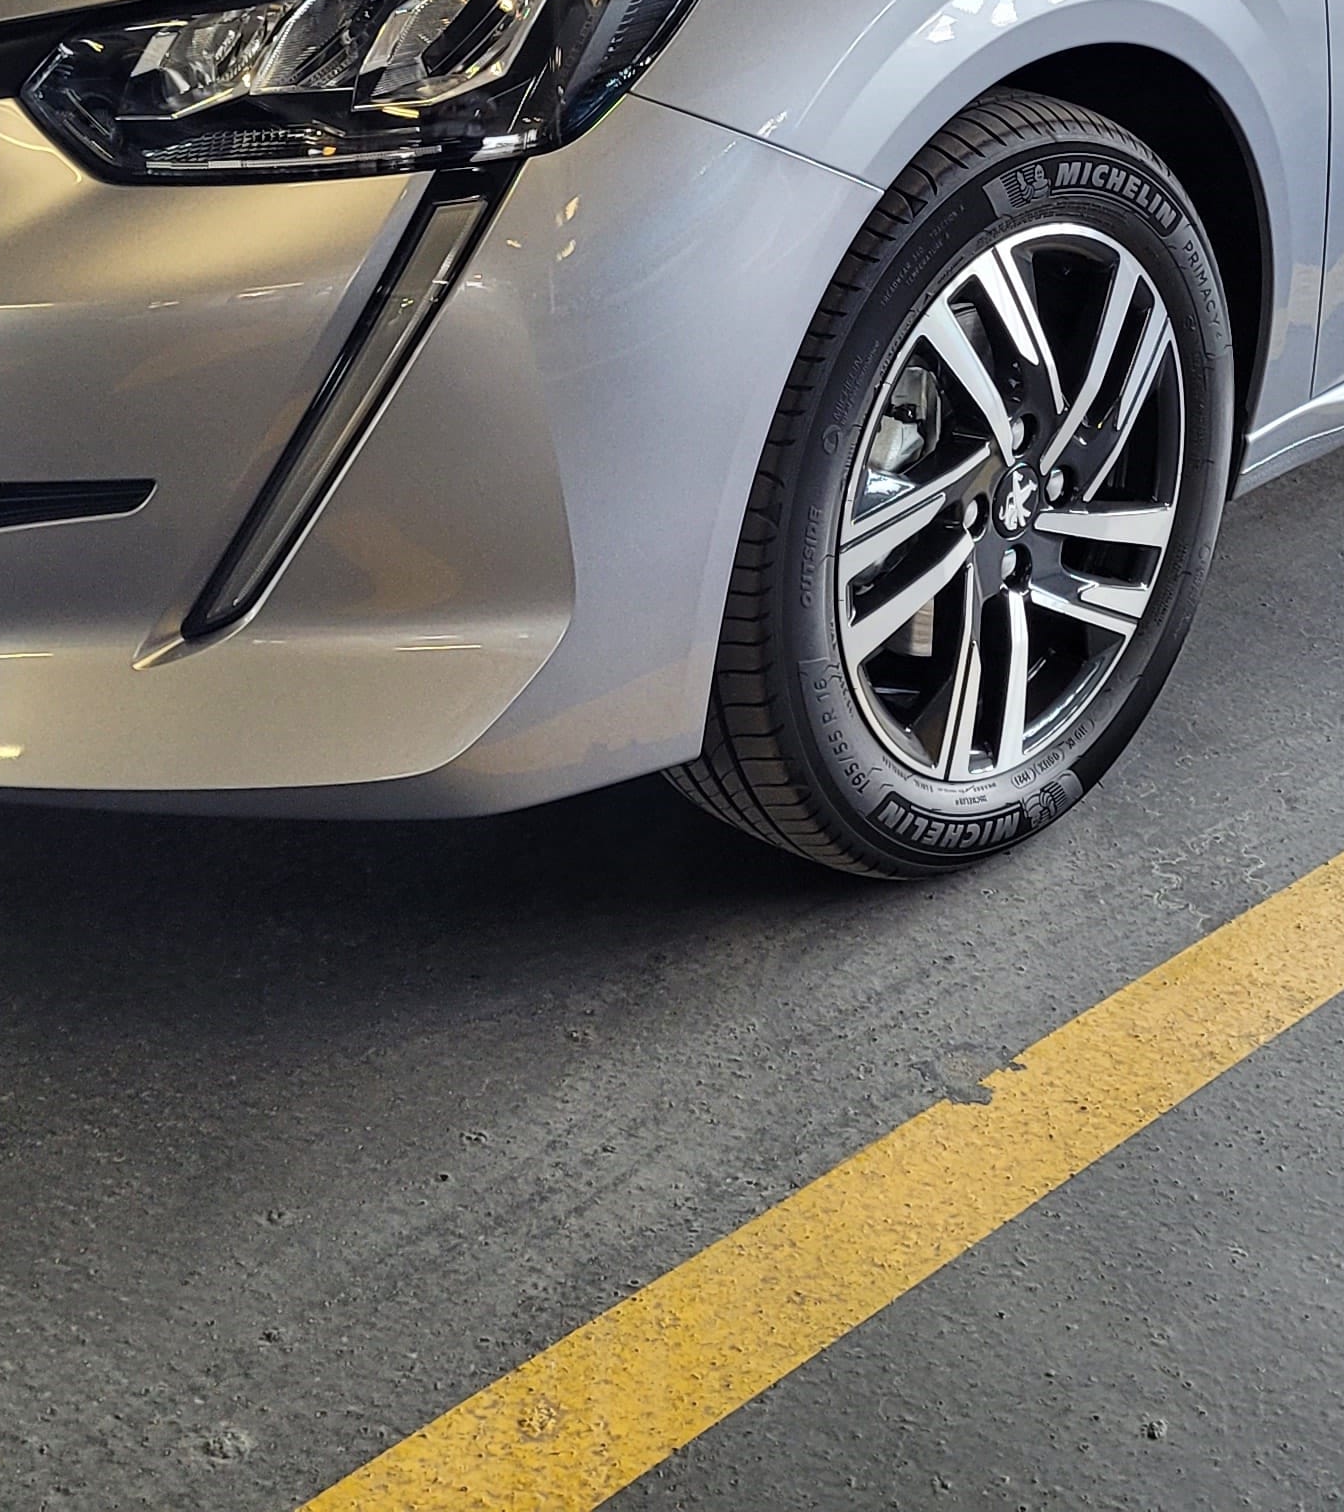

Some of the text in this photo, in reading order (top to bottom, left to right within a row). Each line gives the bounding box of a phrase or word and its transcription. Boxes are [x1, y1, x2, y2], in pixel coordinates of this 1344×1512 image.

[1055, 161, 1178, 230] MICHELIN
[1182, 239, 1220, 326] PRIMACY
[799, 505, 823, 609] OUTSIDE
[814, 677, 828, 703] 16
[822, 707, 837, 724] R
[828, 729, 872, 794] 195/55
[877, 801, 1021, 849] MICHELIN
